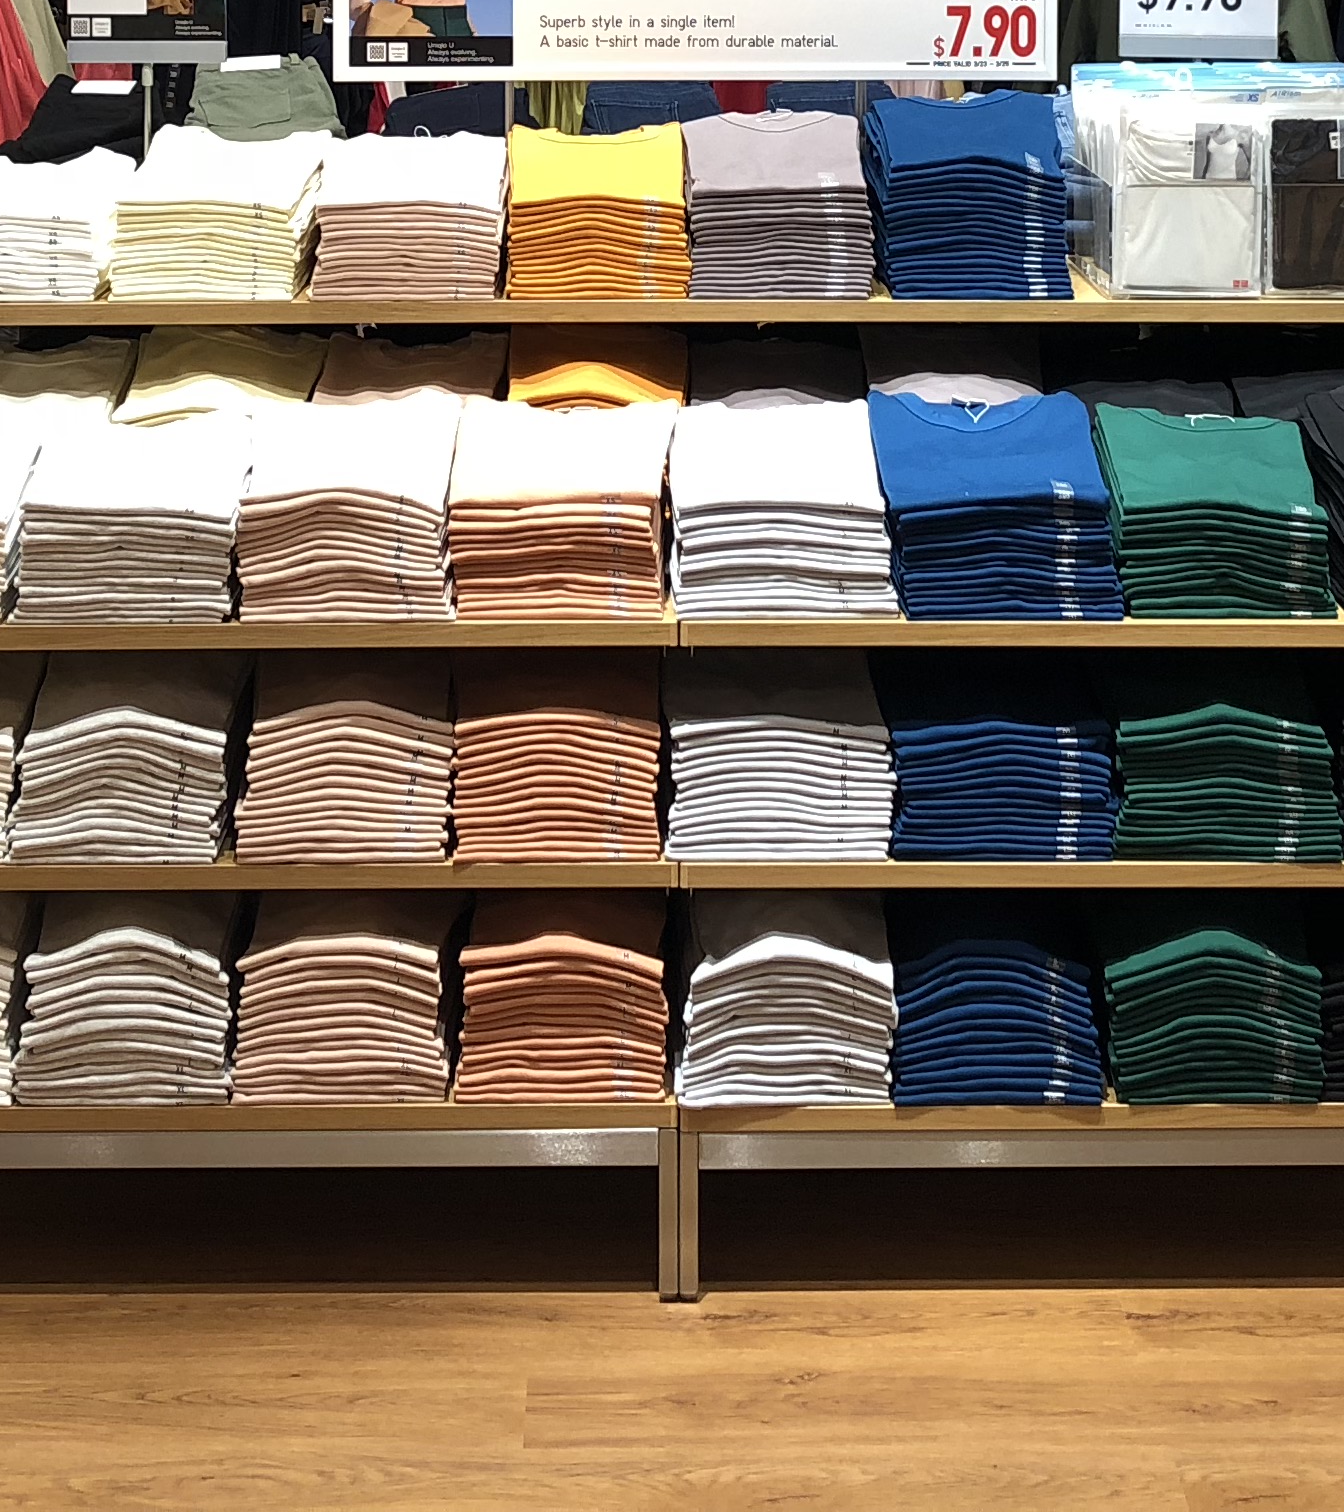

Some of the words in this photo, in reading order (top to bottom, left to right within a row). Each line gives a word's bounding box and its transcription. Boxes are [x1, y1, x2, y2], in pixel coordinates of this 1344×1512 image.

[540, 15, 586, 31] Superb
[591, 15, 622, 31] style
[629, 15, 640, 28] in
[647, 18, 654, 28] a
[660, 15, 697, 31] single
[703, 15, 736, 28] item!
[934, 5, 1036, 58] $7.90
[540, 35, 550, 48] A
[556, 35, 589, 48] basic
[595, 35, 638, 48] t-shirt
[644, 35, 681, 48] made
[687, 35, 719, 48] from
[725, 35, 775, 48] durable
[781, 35, 838, 48] material.
[1247, 94, 1259, 102] XS
